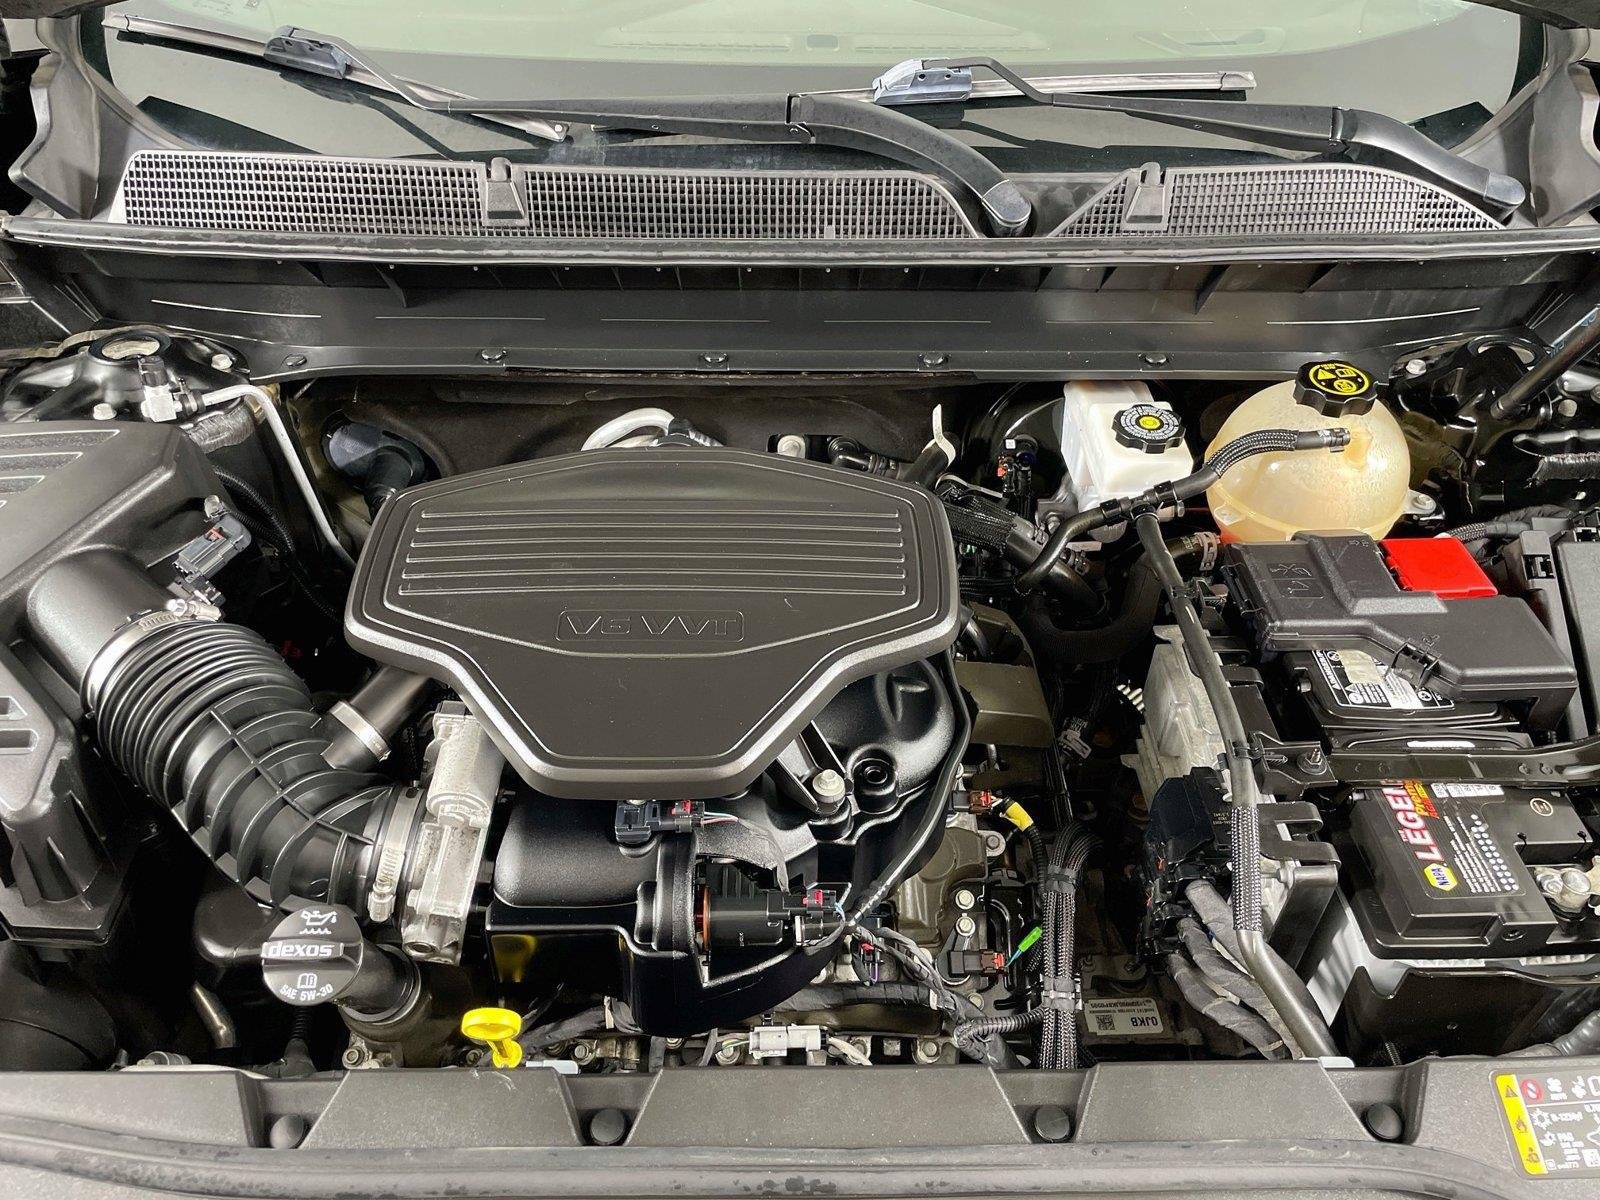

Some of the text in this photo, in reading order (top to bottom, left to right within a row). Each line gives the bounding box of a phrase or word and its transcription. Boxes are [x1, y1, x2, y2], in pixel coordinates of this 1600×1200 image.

[566, 615, 737, 636] V6 VVT
[1380, 779, 1445, 862] LEGEN
[1431, 867, 1450, 886] NAPA
[268, 941, 335, 958] dexos
[280, 983, 334, 1001] SAE 5W-30
